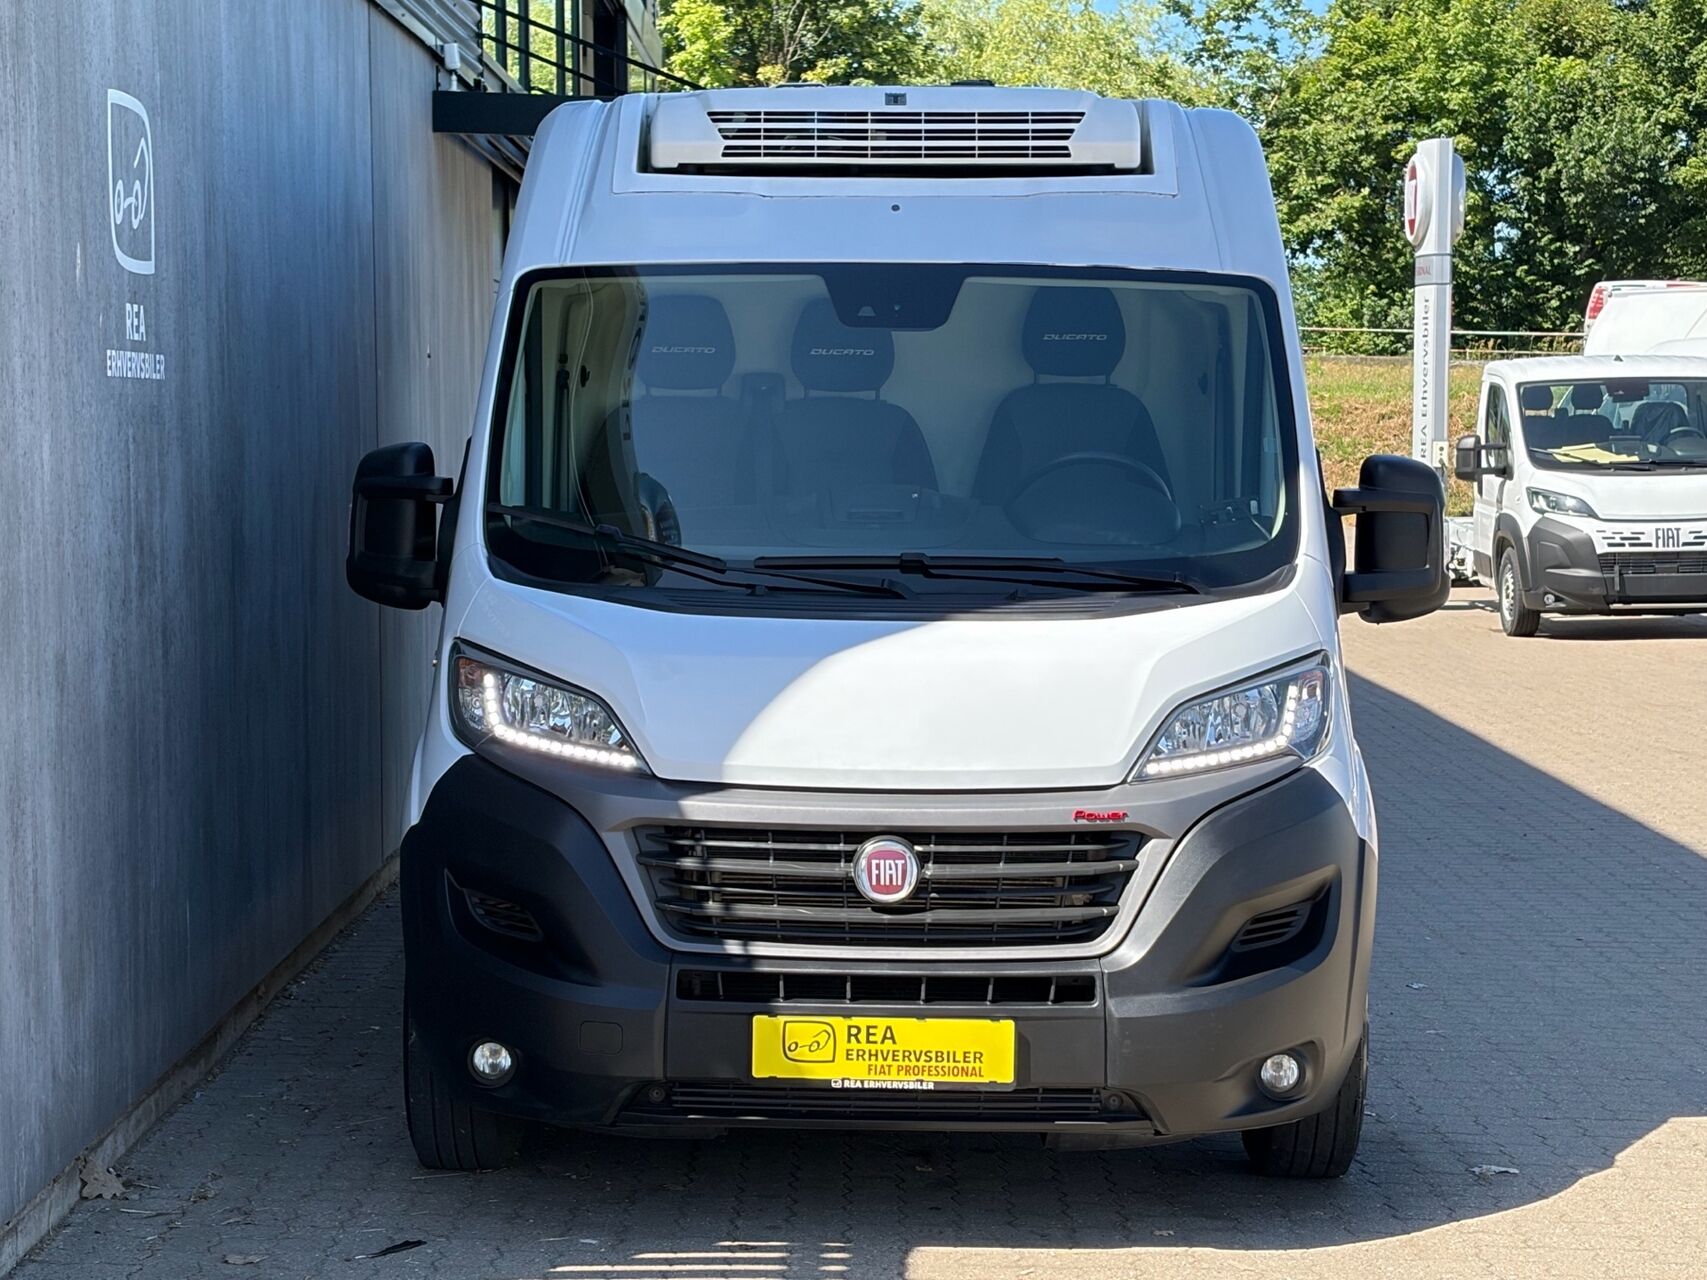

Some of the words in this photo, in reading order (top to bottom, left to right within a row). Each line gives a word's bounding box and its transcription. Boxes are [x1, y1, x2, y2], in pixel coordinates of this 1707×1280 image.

[125, 303, 146, 342] REA
[1042, 333, 1108, 341] DUCATO
[652, 345, 716, 354] DUCATO
[809, 347, 875, 356] DUCATO
[1420, 296, 1430, 418] Erhvervsbiler
[106, 349, 166, 380] ERHVERVSBILER
[1420, 424, 1428, 459] REA
[1655, 527, 1682, 549] FIAT
[1072, 807, 1130, 823] Power
[871, 859, 905, 886] FIAT
[846, 1024, 898, 1045] REA
[845, 1048, 985, 1064] ERHVERVSBILER
[867, 1063, 893, 1076] FIAT
[896, 1064, 985, 1078] PROFESSIONAL
[843, 1079, 862, 1089] REA
[863, 1079, 935, 1090] ERHVERVSBILER
